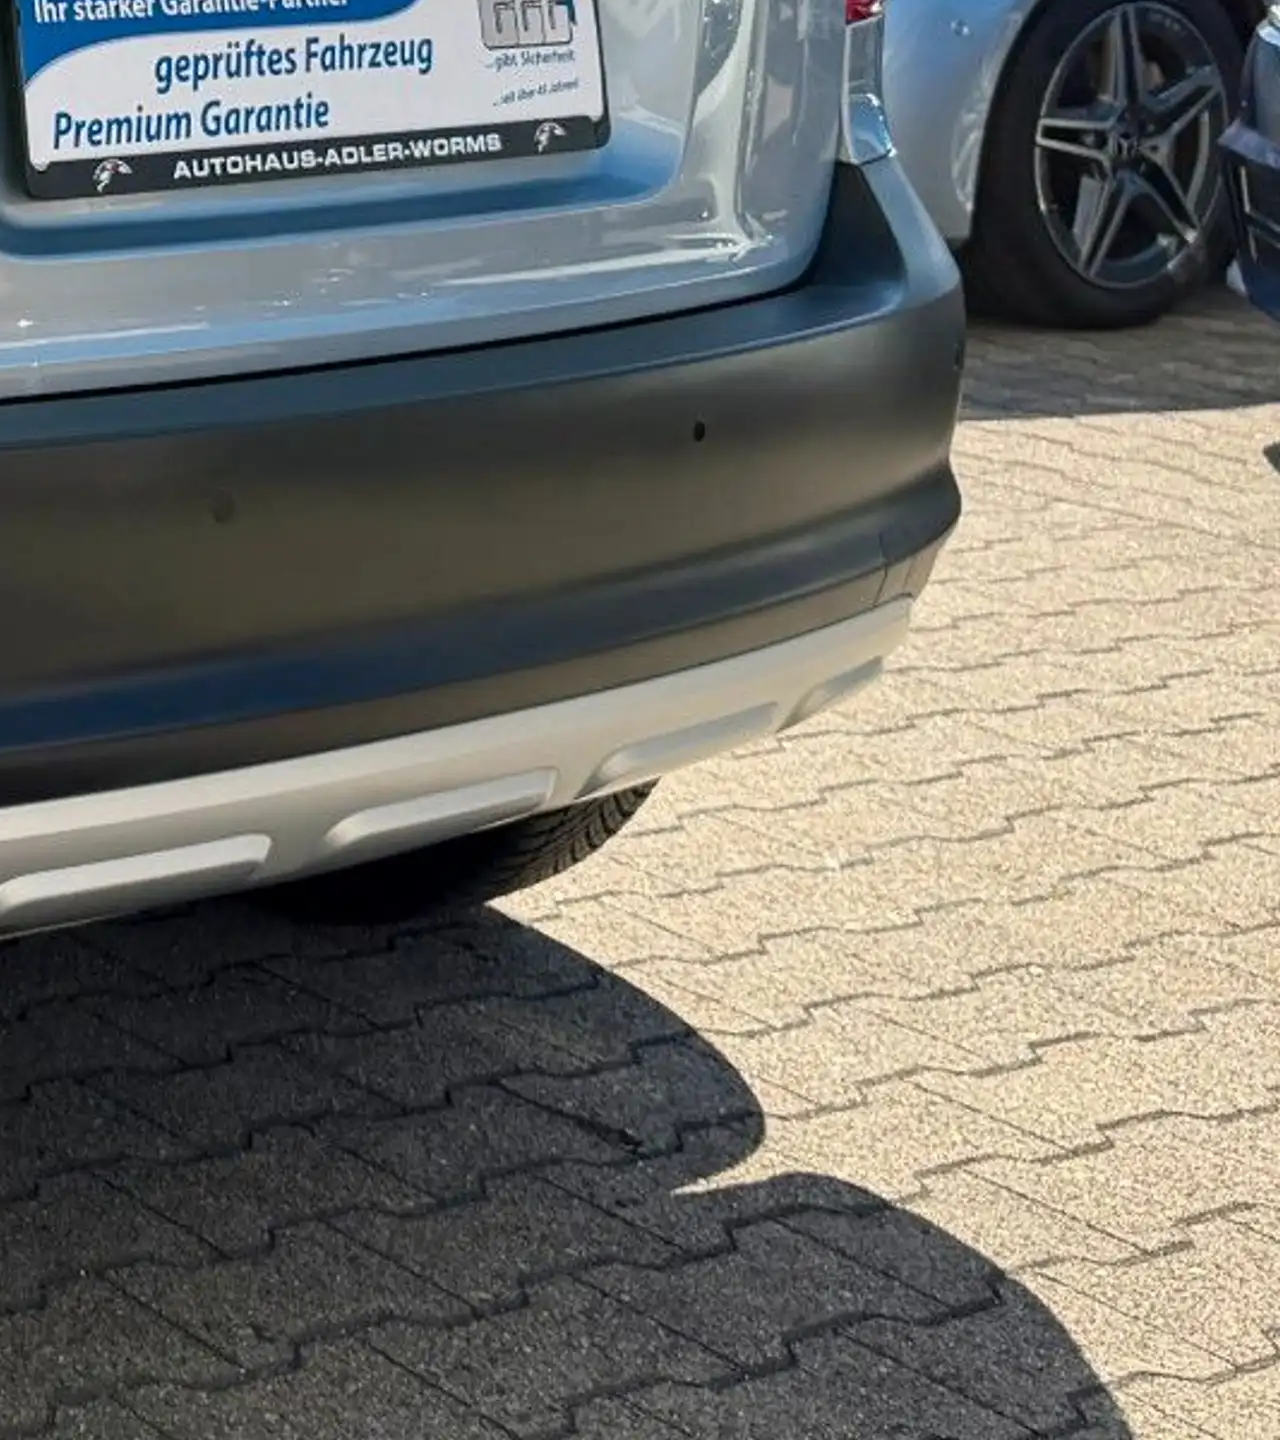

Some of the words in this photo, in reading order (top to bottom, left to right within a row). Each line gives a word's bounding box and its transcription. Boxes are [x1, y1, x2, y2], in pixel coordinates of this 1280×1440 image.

[154, 38, 298, 95] geprüftes
[304, 33, 434, 75] Fahrzeug
[53, 104, 192, 150] Premium
[200, 91, 330, 137] Garantie
